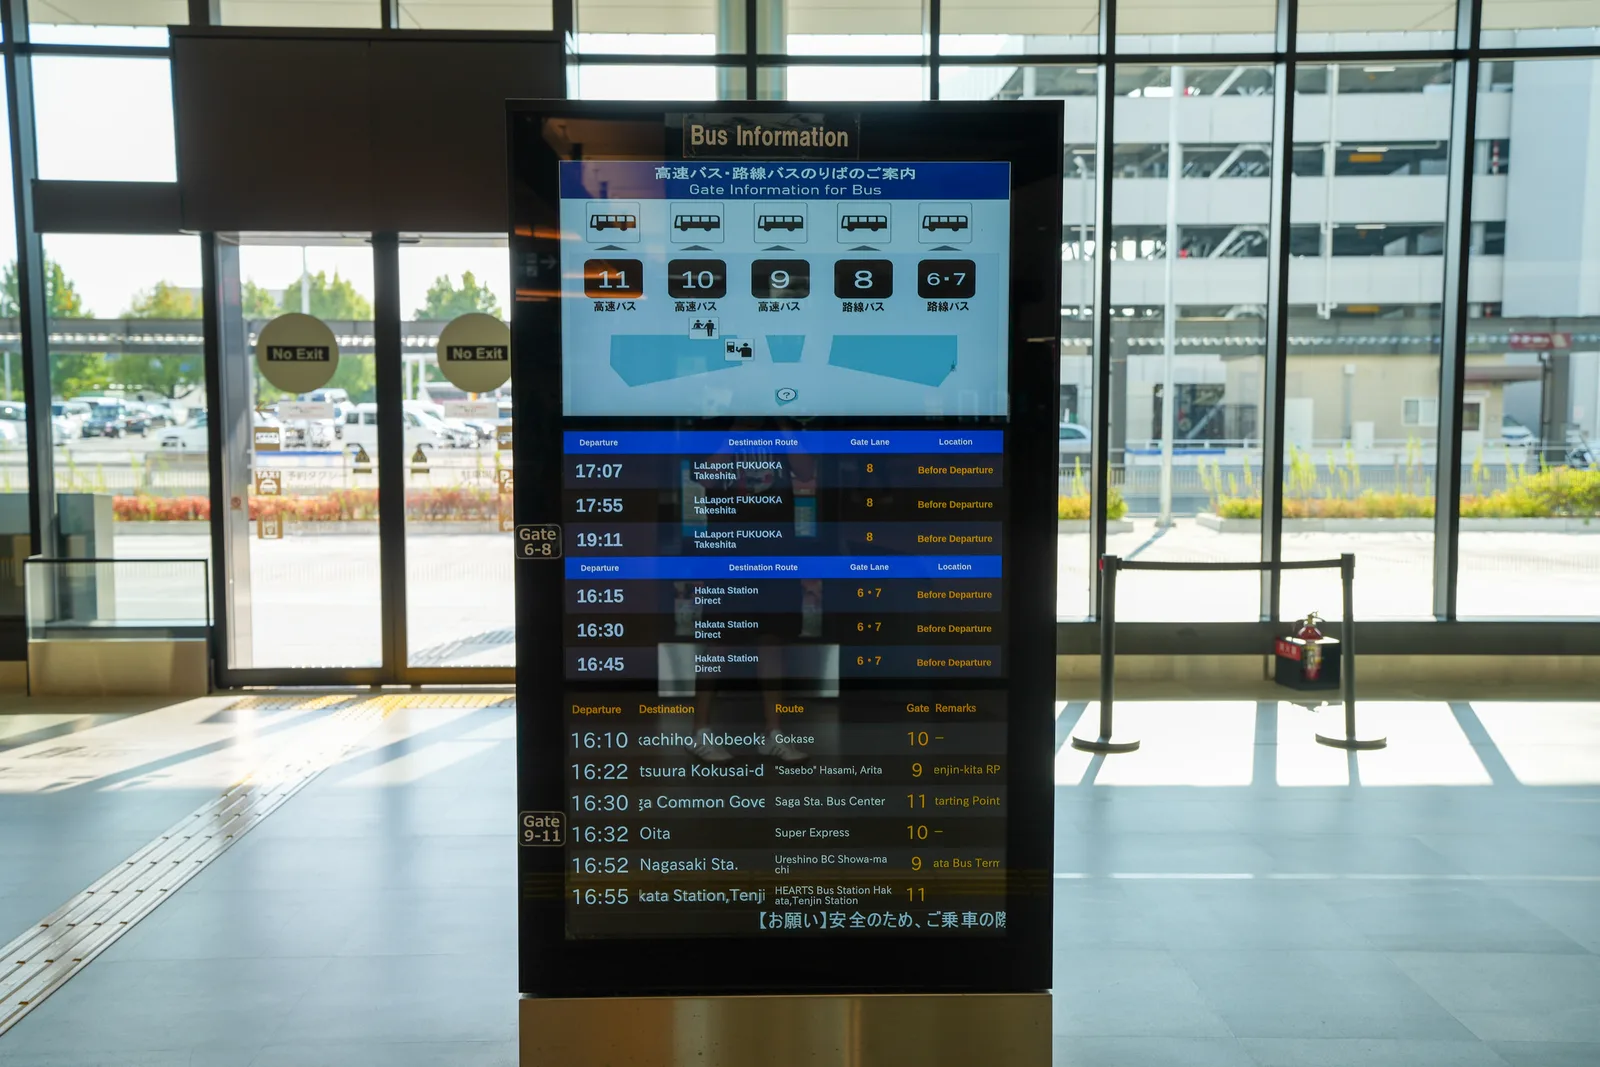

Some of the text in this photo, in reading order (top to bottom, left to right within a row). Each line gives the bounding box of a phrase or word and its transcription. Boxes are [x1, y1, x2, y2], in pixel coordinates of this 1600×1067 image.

[692, 125, 848, 146] Bus Information
[654, 166, 916, 181] 高速バス・路線バスのりばのご案内
[690, 184, 881, 195] Gate Information for Bus
[597, 271, 629, 288] 11
[683, 271, 713, 288] 10
[770, 271, 789, 288] 9
[855, 271, 872, 288] 8
[594, 301, 636, 311] 高速バス
[675, 301, 716, 312] 高速バス
[758, 301, 800, 312] 高速バス
[843, 302, 884, 312] 路線バス
[927, 301, 969, 312] 路線バス
[273, 348, 324, 360] No Exit
[453, 348, 503, 360] No Exit
[580, 439, 618, 447] Departure
[576, 464, 622, 478] 17:07
[694, 462, 734, 471] LaLaport
[867, 464, 873, 472] 8
[918, 466, 993, 475] Before Departure
[576, 499, 623, 512] 17:55
[694, 496, 734, 506] LaLaport
[867, 498, 873, 507] 8
[950, 501, 992, 510] Departure
[694, 505, 737, 515] Takeshita
[520, 528, 556, 540] Gate
[578, 533, 623, 546] 19:11
[695, 531, 734, 539] LaLaport
[867, 532, 873, 541] 8
[949, 535, 992, 544] Departure
[525, 543, 551, 555] 6-8
[581, 565, 619, 573] Departure
[728, 586, 758, 594] Station
[949, 591, 992, 600] Departure
[578, 589, 623, 603] 16:15
[728, 620, 758, 628] Station
[949, 625, 991, 634] Departure
[578, 623, 623, 637] 16:30
[728, 654, 758, 662] Station
[949, 659, 991, 667] Departure
[578, 657, 624, 671] 16:45
[573, 705, 621, 715] Departure
[640, 705, 694, 713] Destination
[776, 704, 804, 712] Route
[907, 704, 929, 712] Gate
[936, 704, 976, 712] Remarks
[572, 732, 627, 748] 16:10
[775, 734, 814, 743] Gokase
[908, 732, 928, 746] 10
[572, 764, 627, 779] 16:22
[640, 764, 763, 777] tsuura Kokusai-d
[775, 766, 882, 775] "Sasebo" Hasami, Arita
[912, 763, 922, 777] 9
[934, 765, 1000, 776] enjin-kita RP
[572, 795, 628, 811] 16:30
[657, 796, 723, 808] Common
[776, 797, 885, 808] Saga Sta. Bus Center
[908, 794, 924, 808] 11
[935, 796, 1000, 807] tarting Point
[524, 816, 559, 827] Gate
[525, 830, 560, 841] 9-11
[573, 826, 628, 842] 16:32
[640, 827, 670, 839] Oita
[776, 828, 849, 838] Super Express
[908, 825, 927, 839] 10
[775, 855, 887, 864] Ureshino BC Showa-ma
[912, 857, 921, 870] 9
[953, 859, 972, 867] Bus
[573, 858, 628, 873] 16:52
[641, 858, 737, 873] Nagasaki Sta.
[775, 865, 789, 874] chi
[776, 886, 891, 894] HEARTS Bus Station Hak
[907, 888, 924, 901] 11
[573, 889, 628, 904] 16:55
[639, 889, 765, 904] kata Station,Tenji
[775, 896, 858, 906] ata,Tenjin Station
